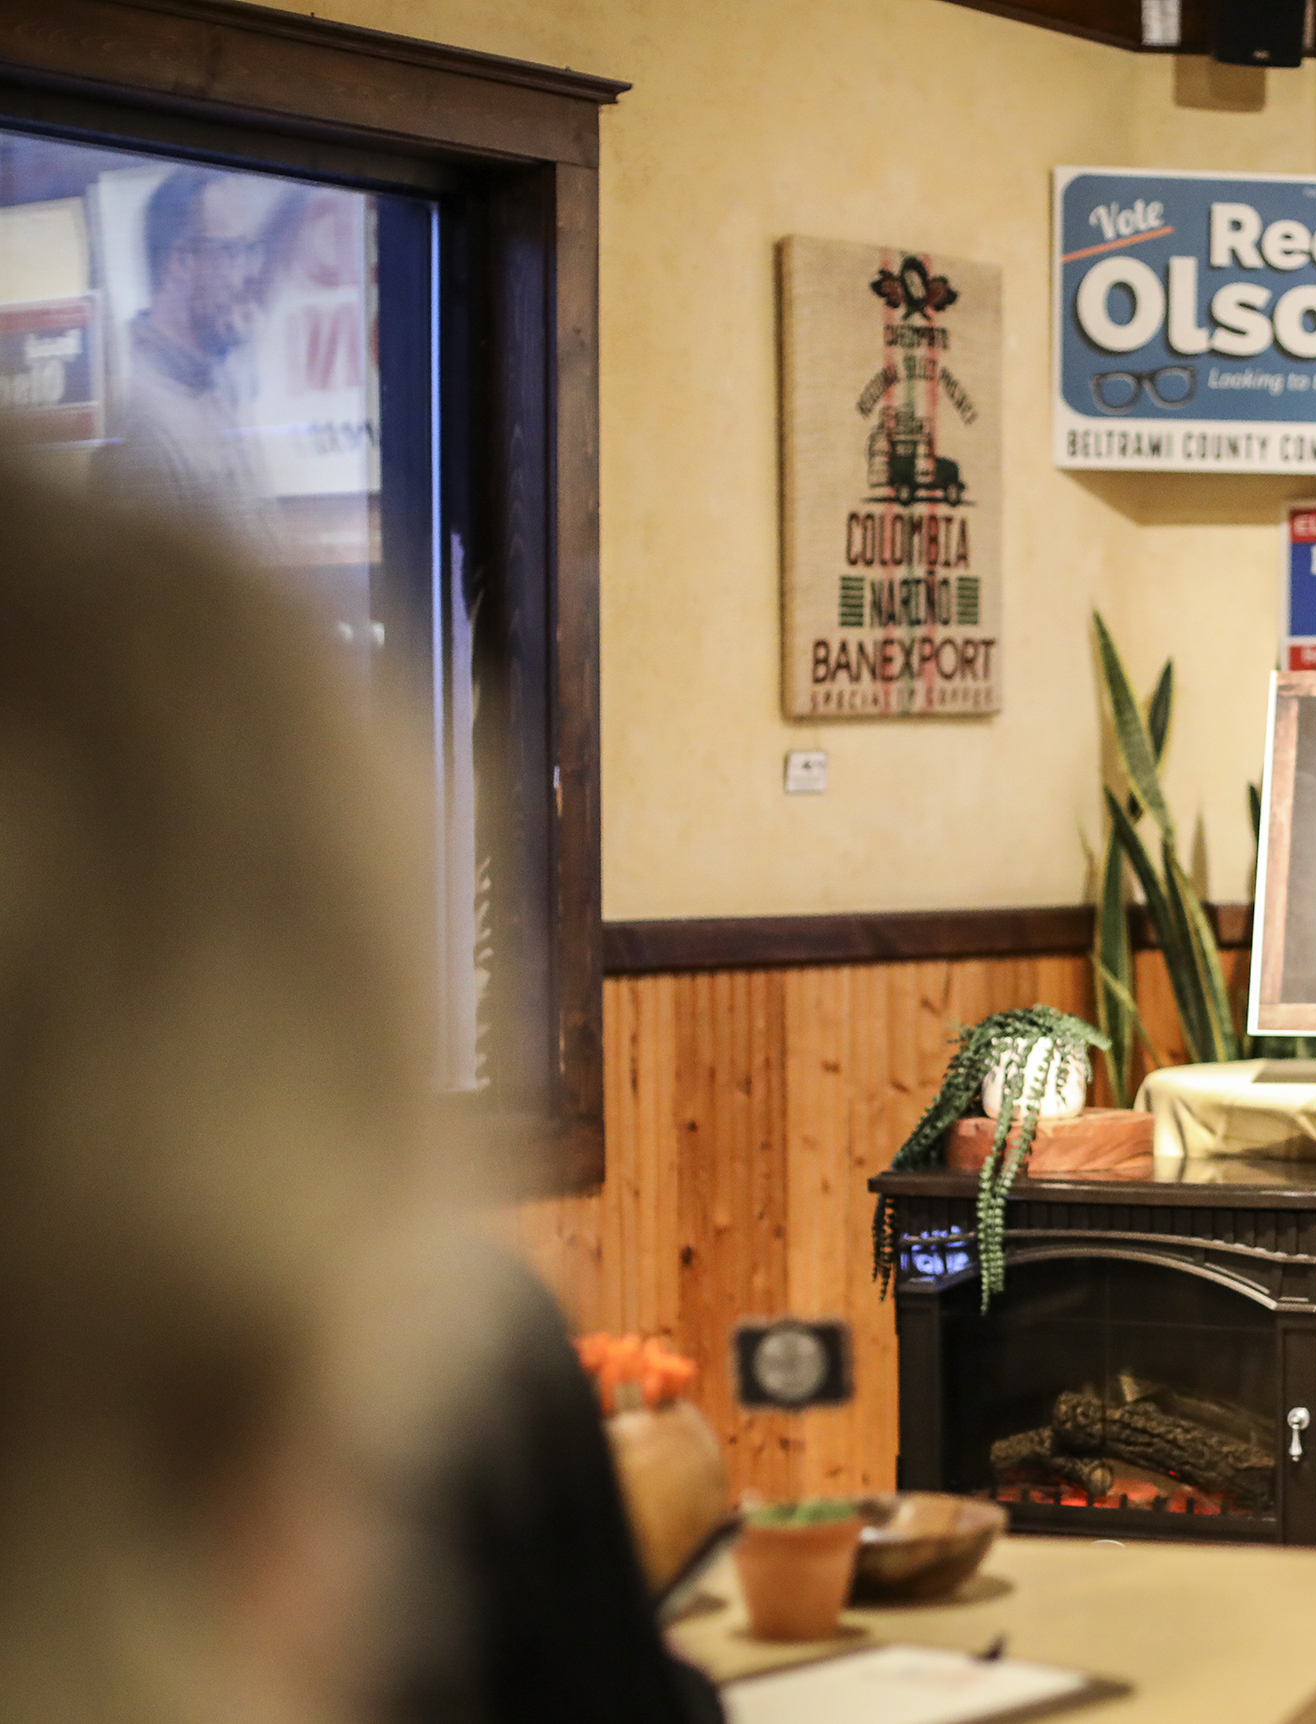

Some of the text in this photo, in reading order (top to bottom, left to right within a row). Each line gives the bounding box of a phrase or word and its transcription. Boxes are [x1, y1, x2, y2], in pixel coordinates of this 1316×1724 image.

[1089, 199, 1166, 241] Vote
[1208, 368, 1285, 396] Looking
[1287, 372, 1307, 392] to
[1066, 429, 1173, 459] BELTRAMI
[1183, 431, 1269, 460] COUNTY
[846, 512, 969, 568] COLOMBIA
[812, 636, 996, 684] BANEXPORT
